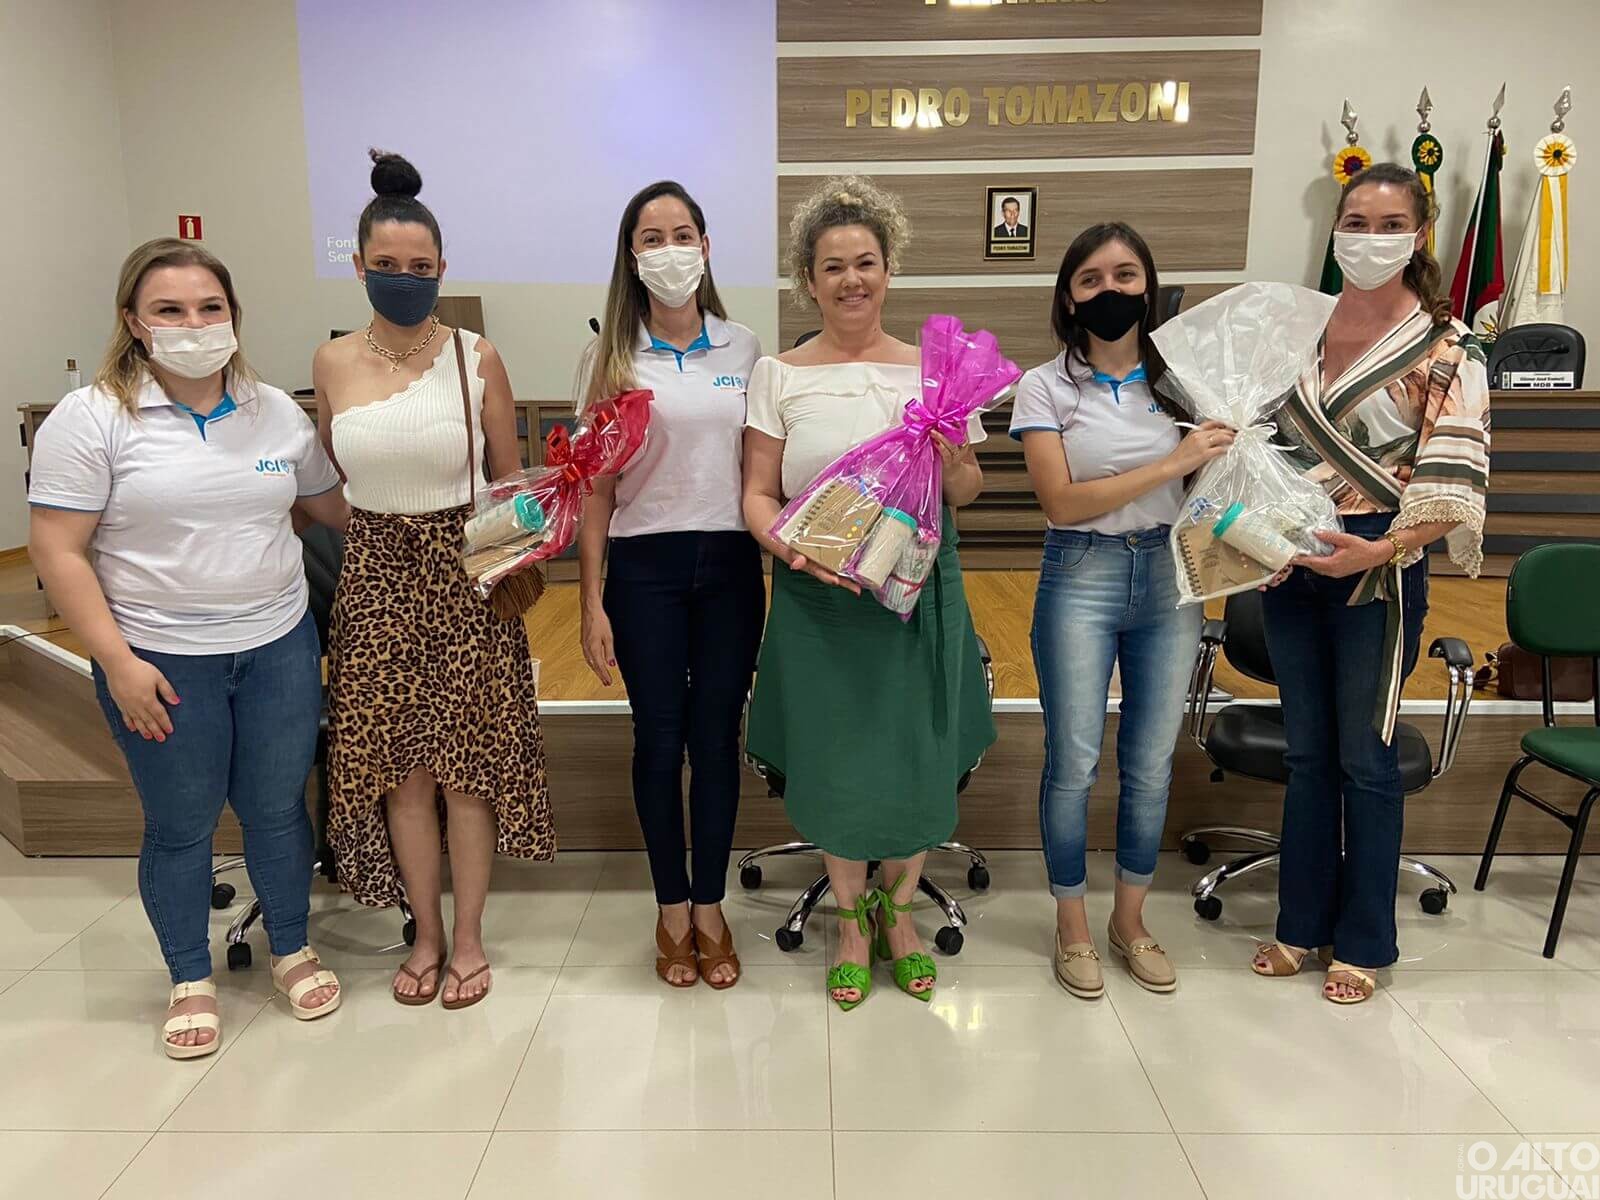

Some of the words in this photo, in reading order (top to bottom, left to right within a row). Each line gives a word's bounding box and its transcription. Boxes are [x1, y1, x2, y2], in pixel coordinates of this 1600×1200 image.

[845, 87, 970, 128] PEDRO
[983, 80, 1190, 126] TOMAZONI
[713, 375, 736, 387] JCI
[255, 459, 281, 472] JCI
